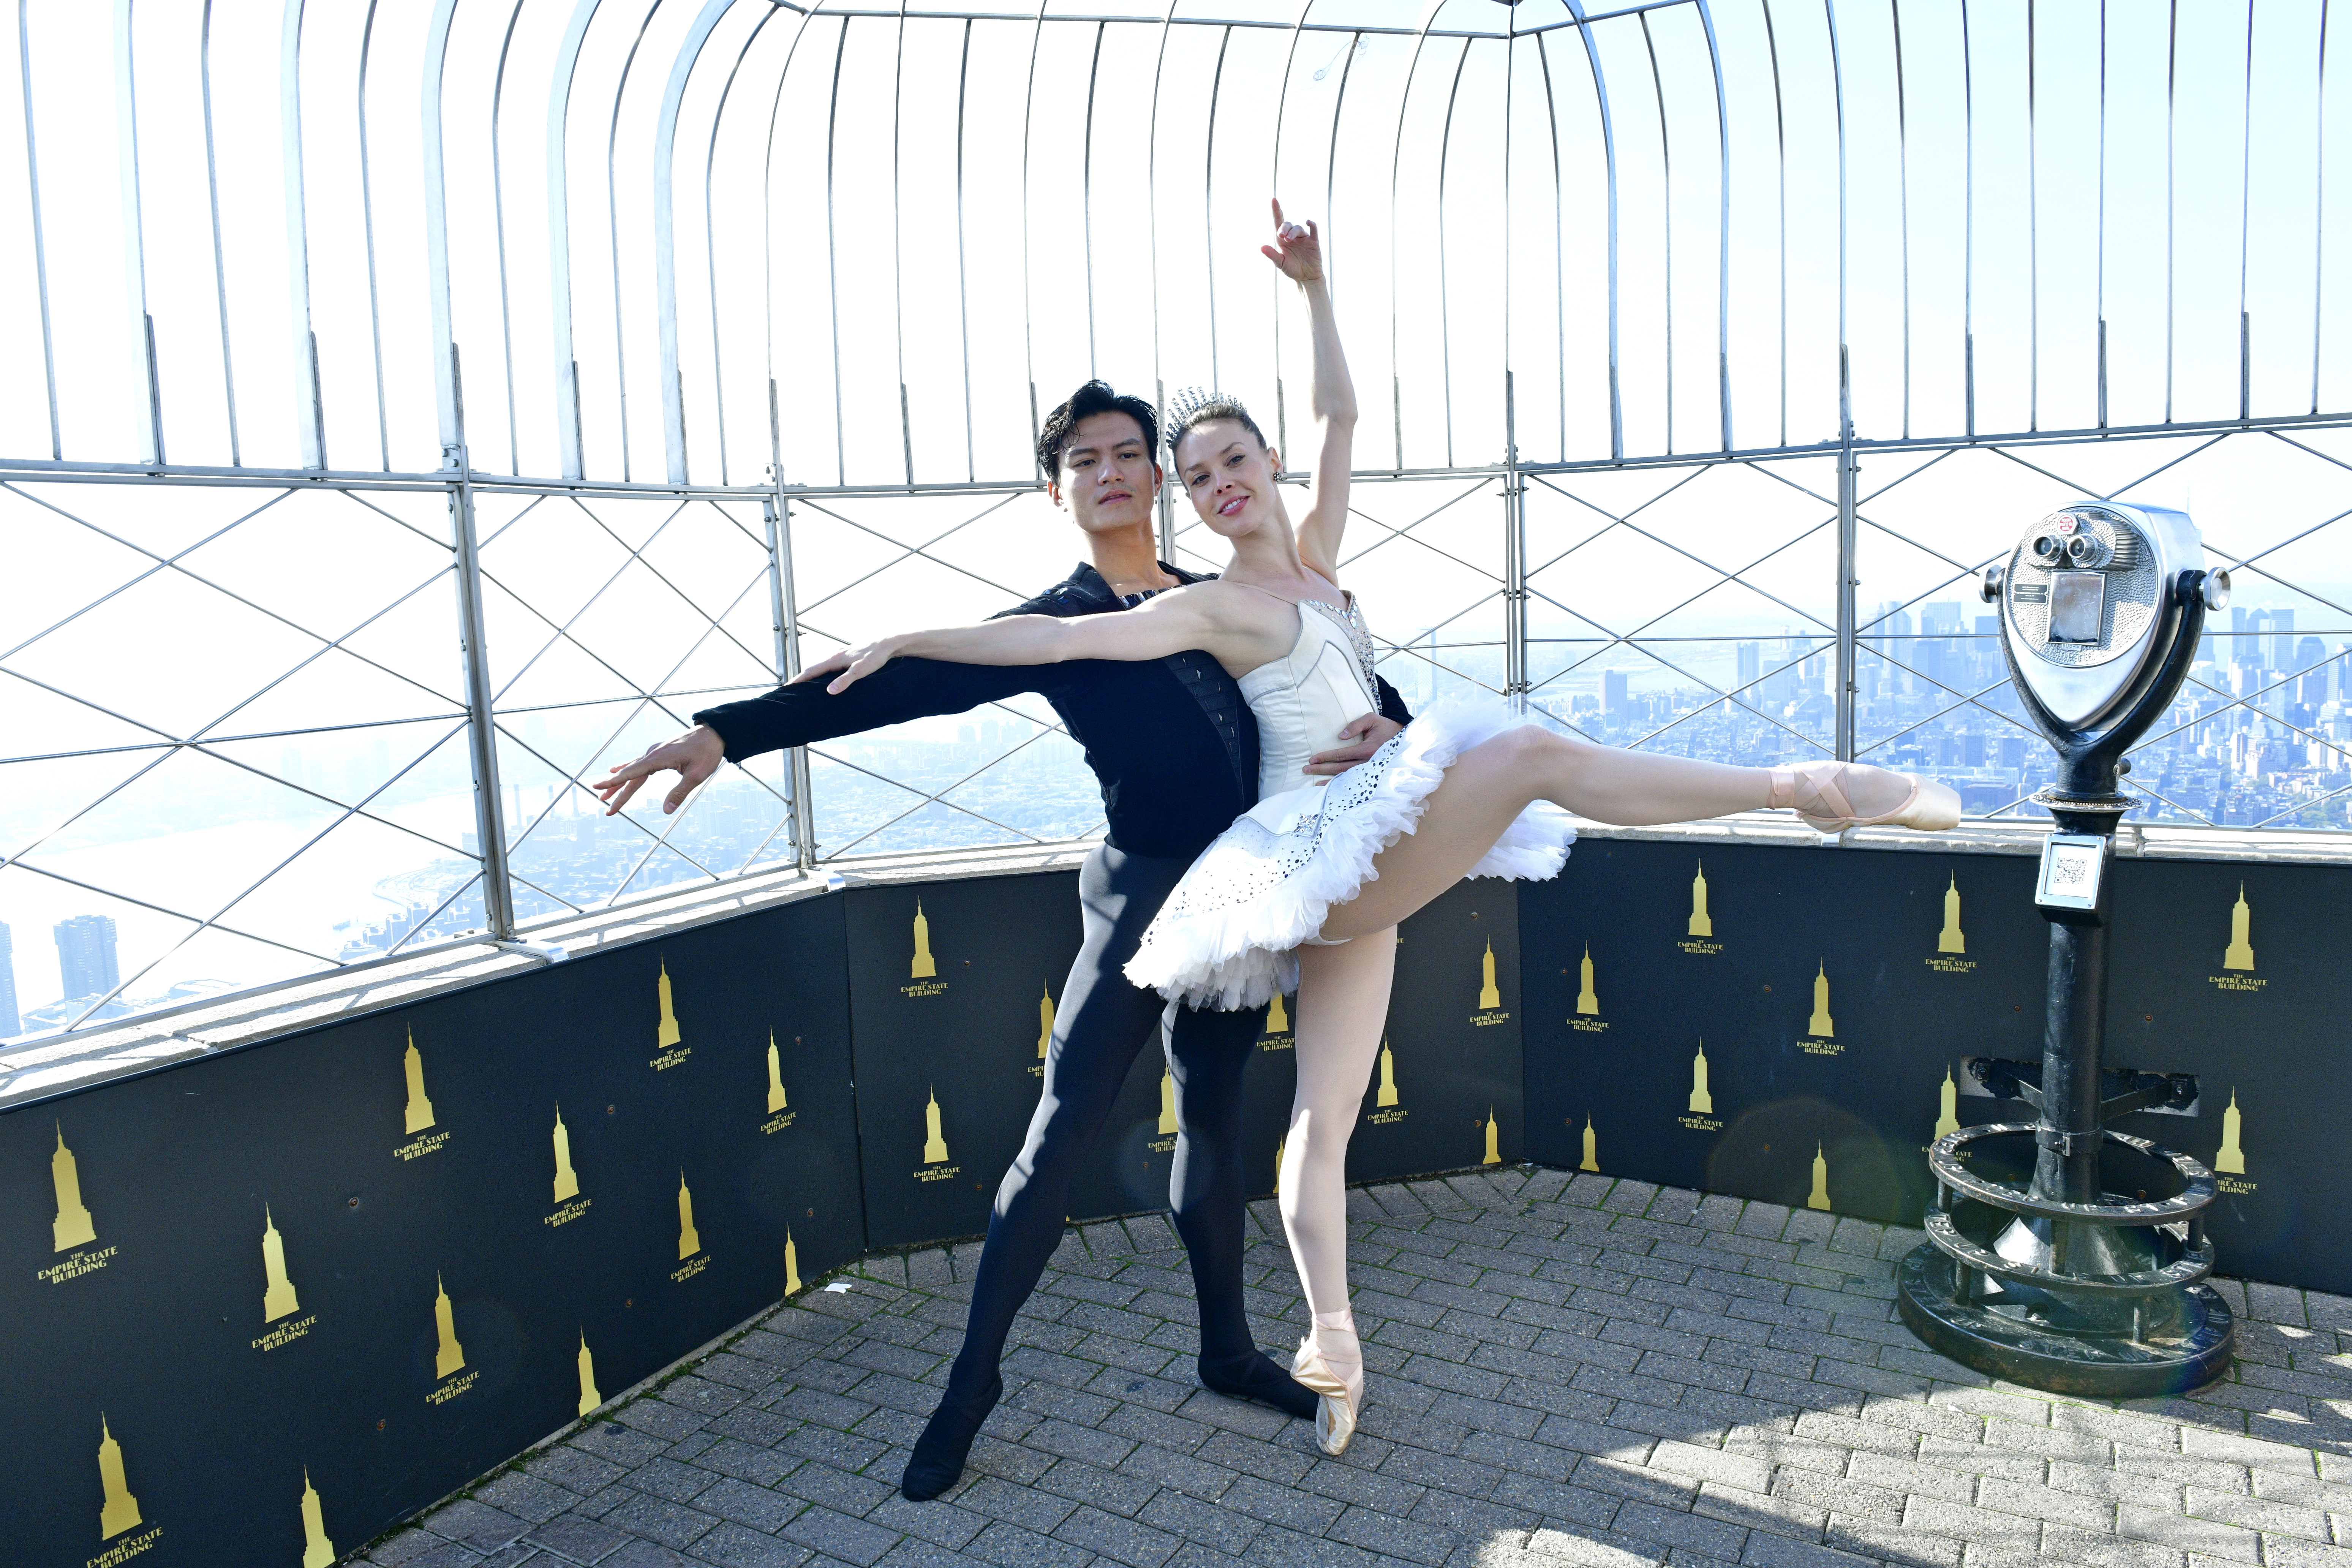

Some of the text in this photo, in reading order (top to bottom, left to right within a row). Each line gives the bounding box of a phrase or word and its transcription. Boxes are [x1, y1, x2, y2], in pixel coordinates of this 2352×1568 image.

[2209, 976, 2240, 984] EMPIRE
[2218, 983, 2258, 991] BUILDING
[901, 985, 927, 993] EMPIRE
[909, 989, 942, 997] BUILDING
[1476, 1018, 1504, 1027] BUILDING
[1263, 1043, 1293, 1051] BUILDING
[1804, 1047, 1837, 1056] BUILDING
[650, 1047, 692, 1067] EMPIRE STATE
[657, 1056, 686, 1071] BUILDING
[760, 1111, 797, 1132] EMPIRE STATE
[767, 1119, 792, 1135] BUILDING
[1374, 1116, 1402, 1125] BUILDING
[1685, 1122, 1716, 1131] BUILDING
[394, 1131, 450, 1157] EMPIRE STATE
[404, 1141, 443, 1161] BUILDING
[914, 1169, 939, 1178] EMPIRE
[921, 1173, 954, 1182] BUILDING
[2218, 1185, 2248, 1195] ILDING
[2233, 1182, 2258, 1190] STATE
[544, 1199, 592, 1224] EMPIRE STATE
[553, 1208, 585, 1228] BUILDING
[38, 1246, 118, 1280] EMPIRE STATE
[70, 1251, 85, 1260] THE
[52, 1258, 107, 1284] BUILDING
[670, 1255, 711, 1280] EMPIRE STATE
[678, 1264, 706, 1283] BUILDING
[252, 1315, 317, 1349] EMPIRE STATE
[278, 1321, 291, 1329] THE
[264, 1327, 308, 1352] BUILDING
[426, 1371, 480, 1403] EMPIRE STATE
[435, 1381, 473, 1405] BUILDING
[87, 1527, 163, 1568] EMPIRE STATE
[117, 1536, 132, 1546] THE
[100, 1540, 153, 1568] BUILDING
